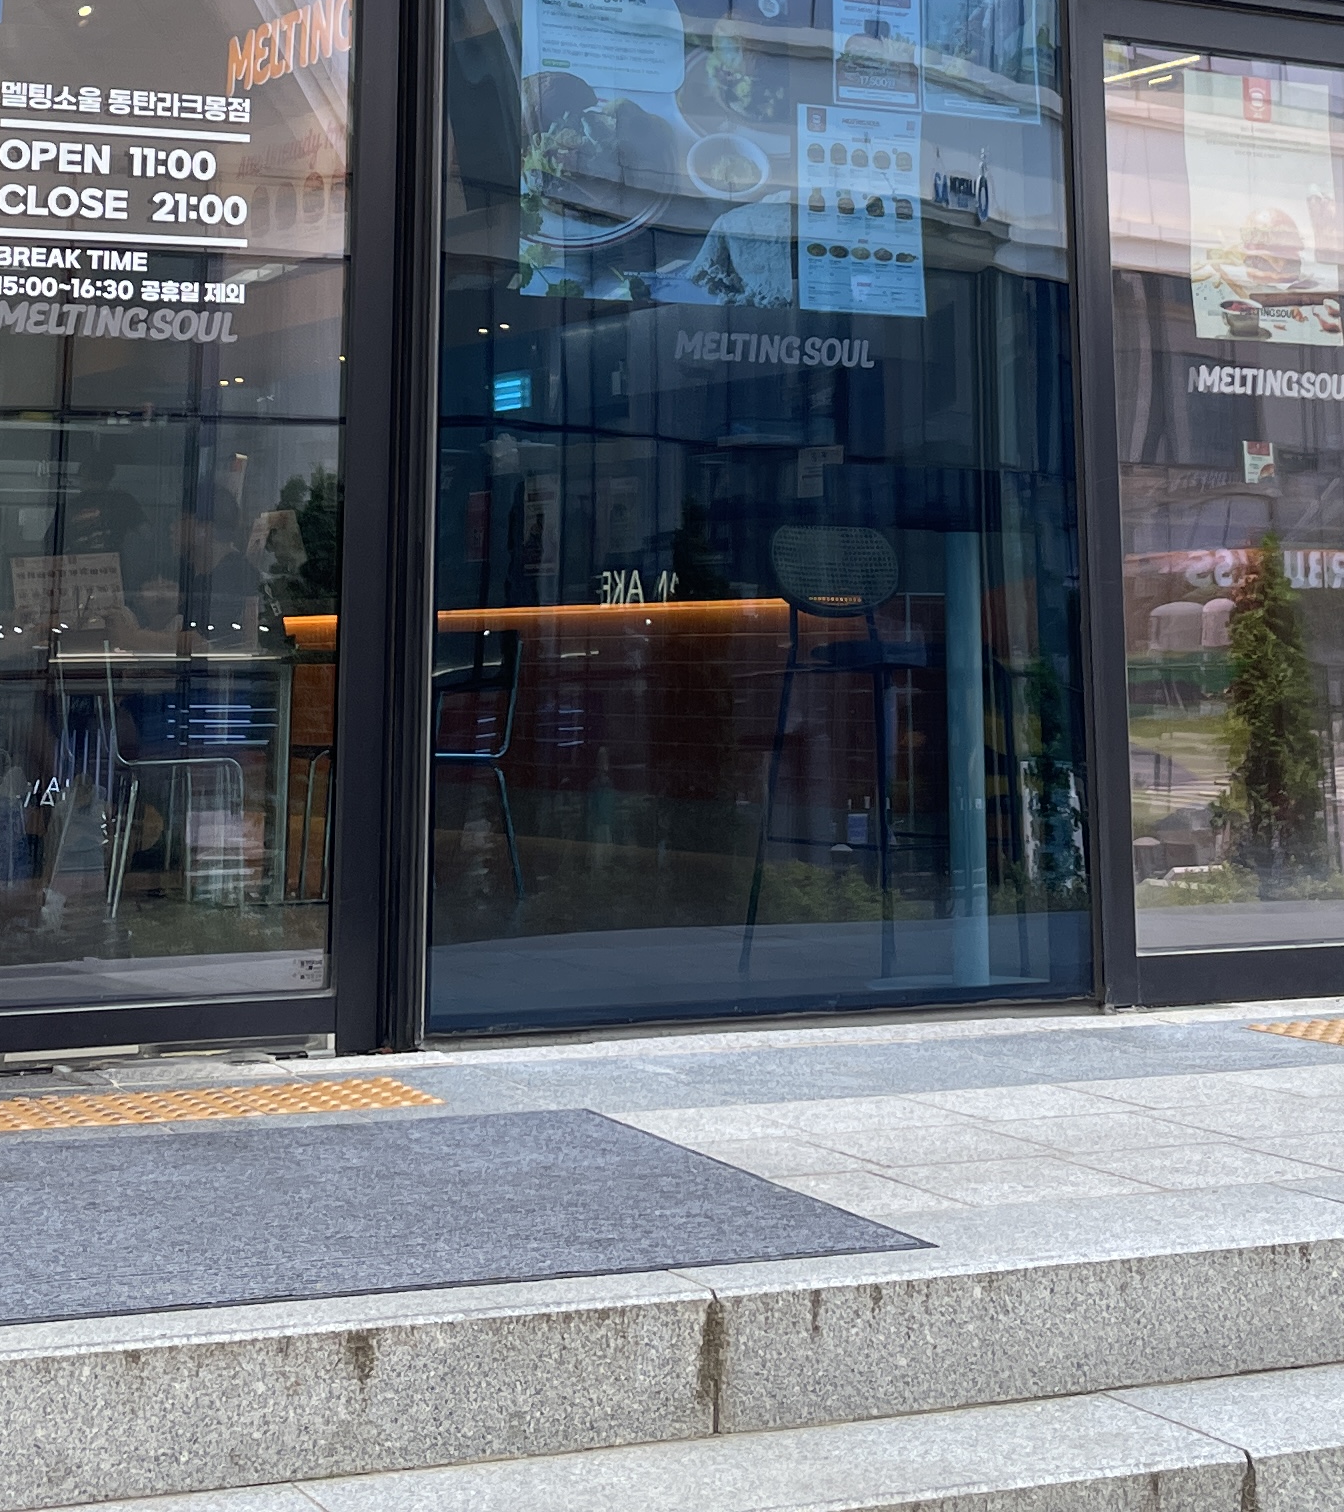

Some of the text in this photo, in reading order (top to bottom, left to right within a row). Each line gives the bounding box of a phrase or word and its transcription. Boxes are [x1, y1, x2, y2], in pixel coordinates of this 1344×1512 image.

[1, 81, 251, 123] 멜팅소울 동탄라크몽점
[129, 146, 217, 181] 11:00
[152, 191, 248, 226] 21:00
[86, 250, 148, 272] TIME
[140, 280, 199, 303] 공휴일
[204, 282, 245, 304] 제외
